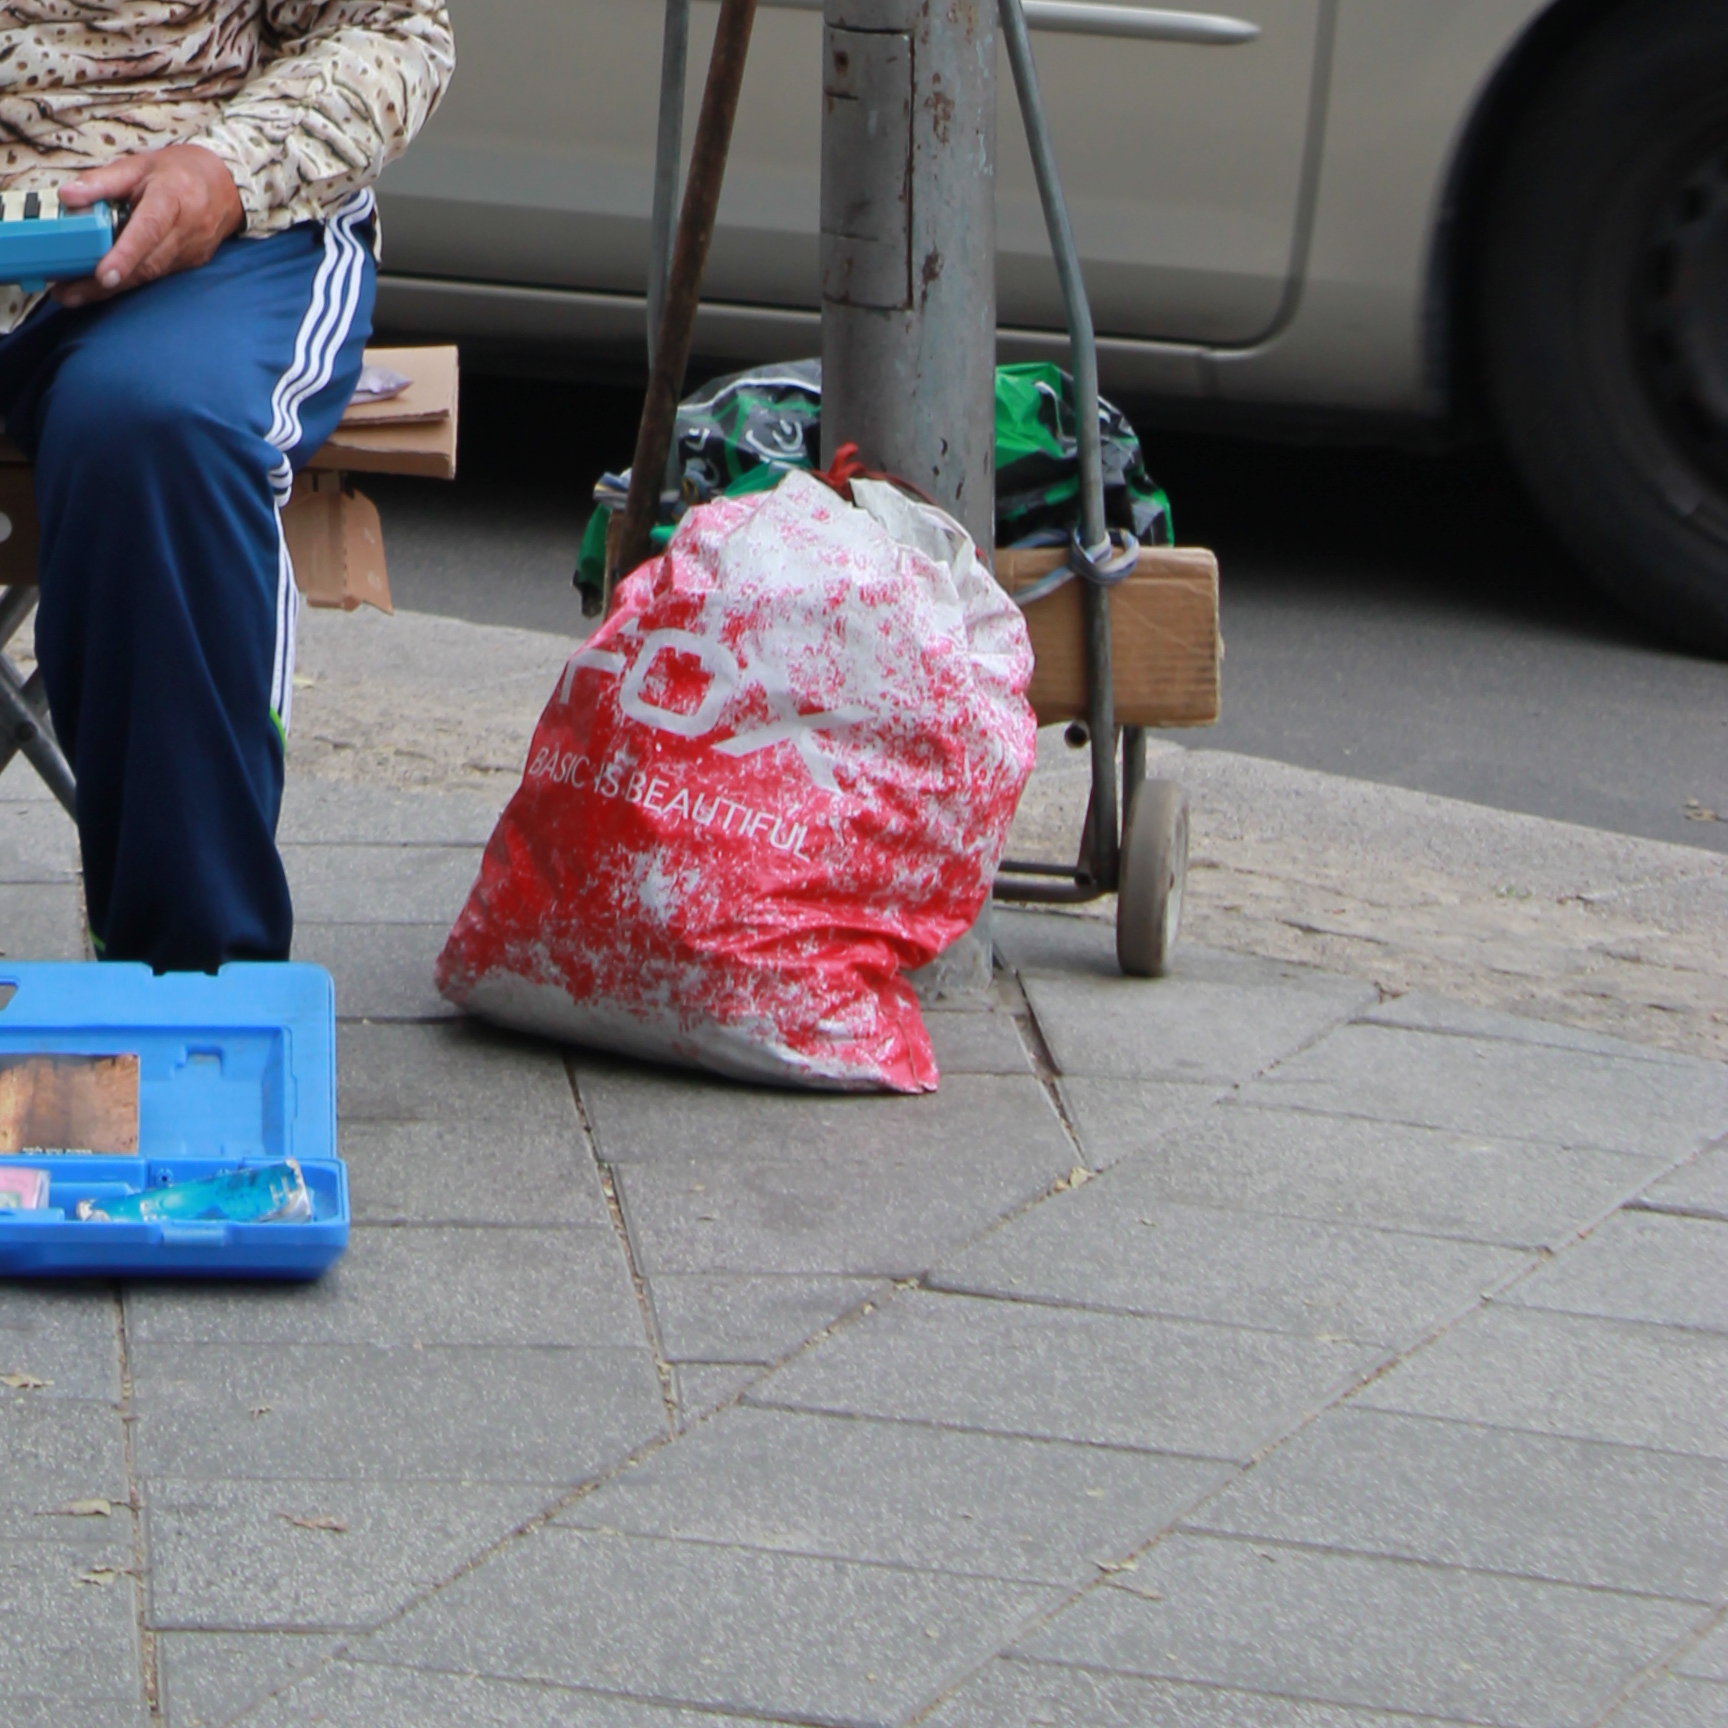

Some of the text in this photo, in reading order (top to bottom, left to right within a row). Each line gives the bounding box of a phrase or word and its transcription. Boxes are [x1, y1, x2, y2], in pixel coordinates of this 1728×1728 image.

[528, 746, 813, 864] BASIC IS BEAUTIFUL
